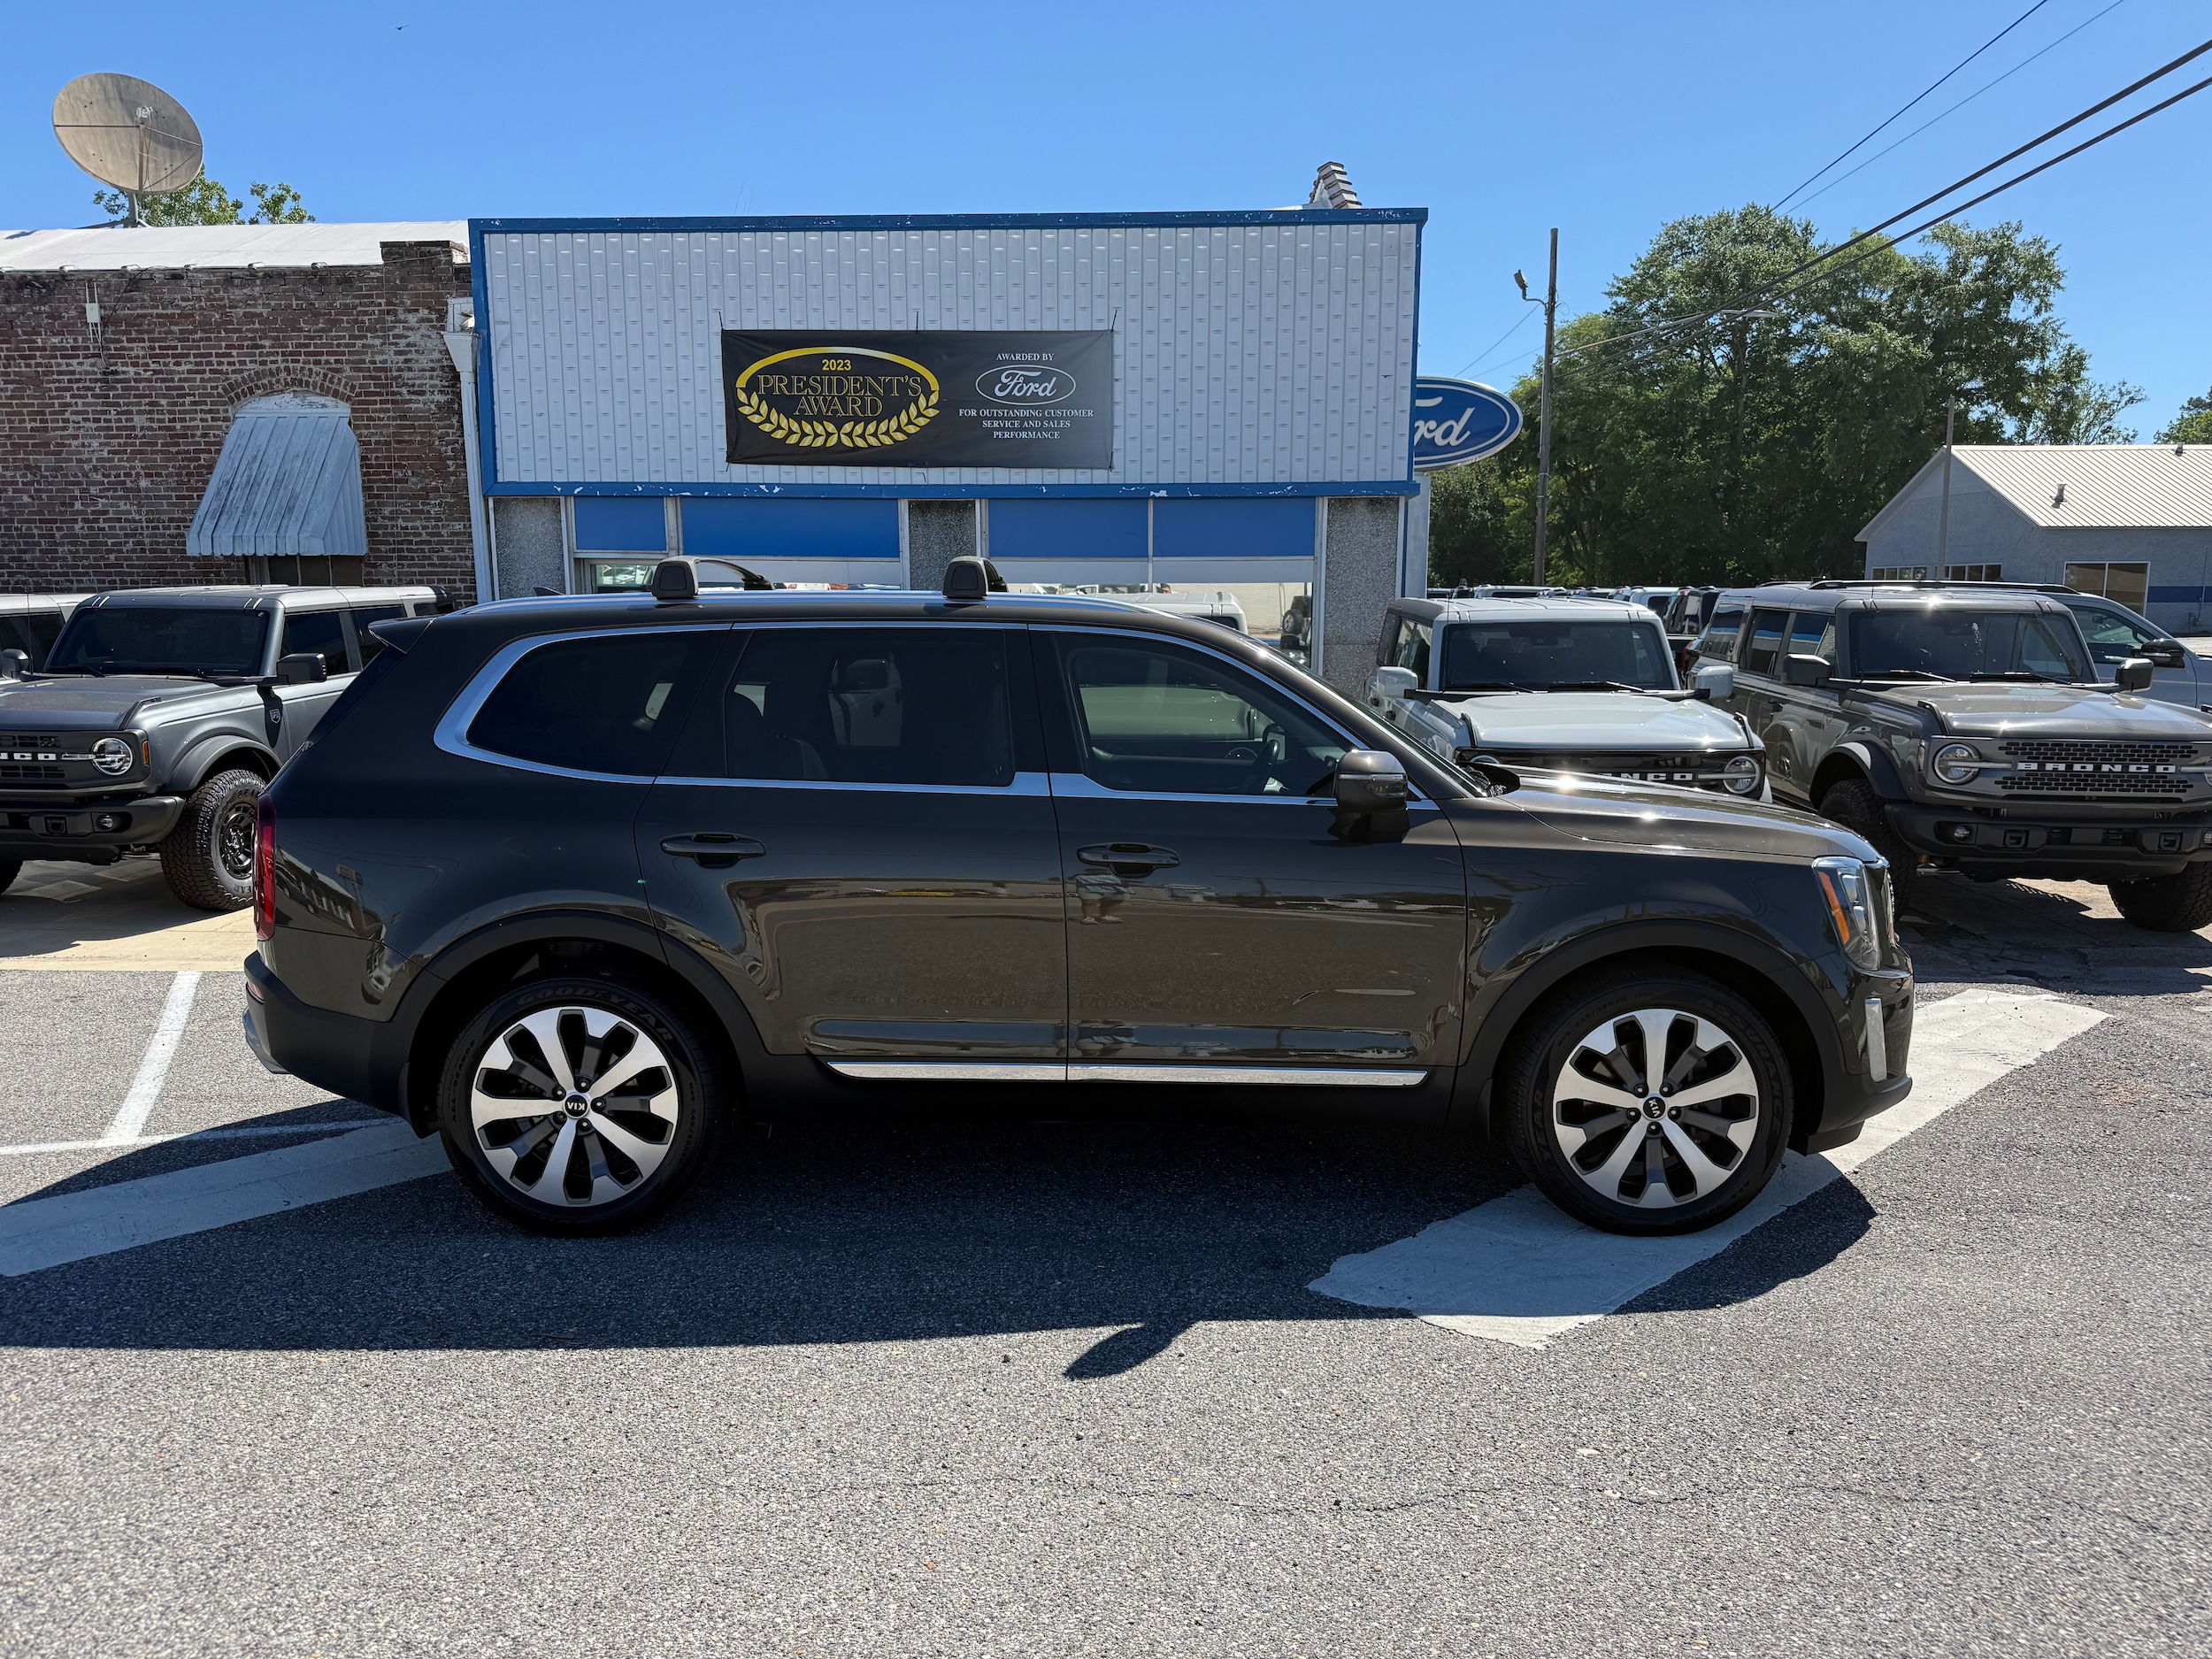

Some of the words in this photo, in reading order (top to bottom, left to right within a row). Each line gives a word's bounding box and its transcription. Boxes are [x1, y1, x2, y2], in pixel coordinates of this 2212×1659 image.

[821, 358, 852, 372] 2023
[757, 374, 922, 397] PRESIDENT'S
[994, 370, 1057, 397] Ford
[793, 396, 883, 418] AWARD
[1044, 409, 1094, 418] CUSTOMER
[1414, 396, 1476, 446] rd
[2016, 762, 2177, 773] BRONCO
[518, 987, 673, 1041] GOODYEAR
[1694, 998, 1784, 1135] ASSURANCE
[566, 1101, 586, 1111] KIA
[1648, 1098, 1661, 1118] KIA
